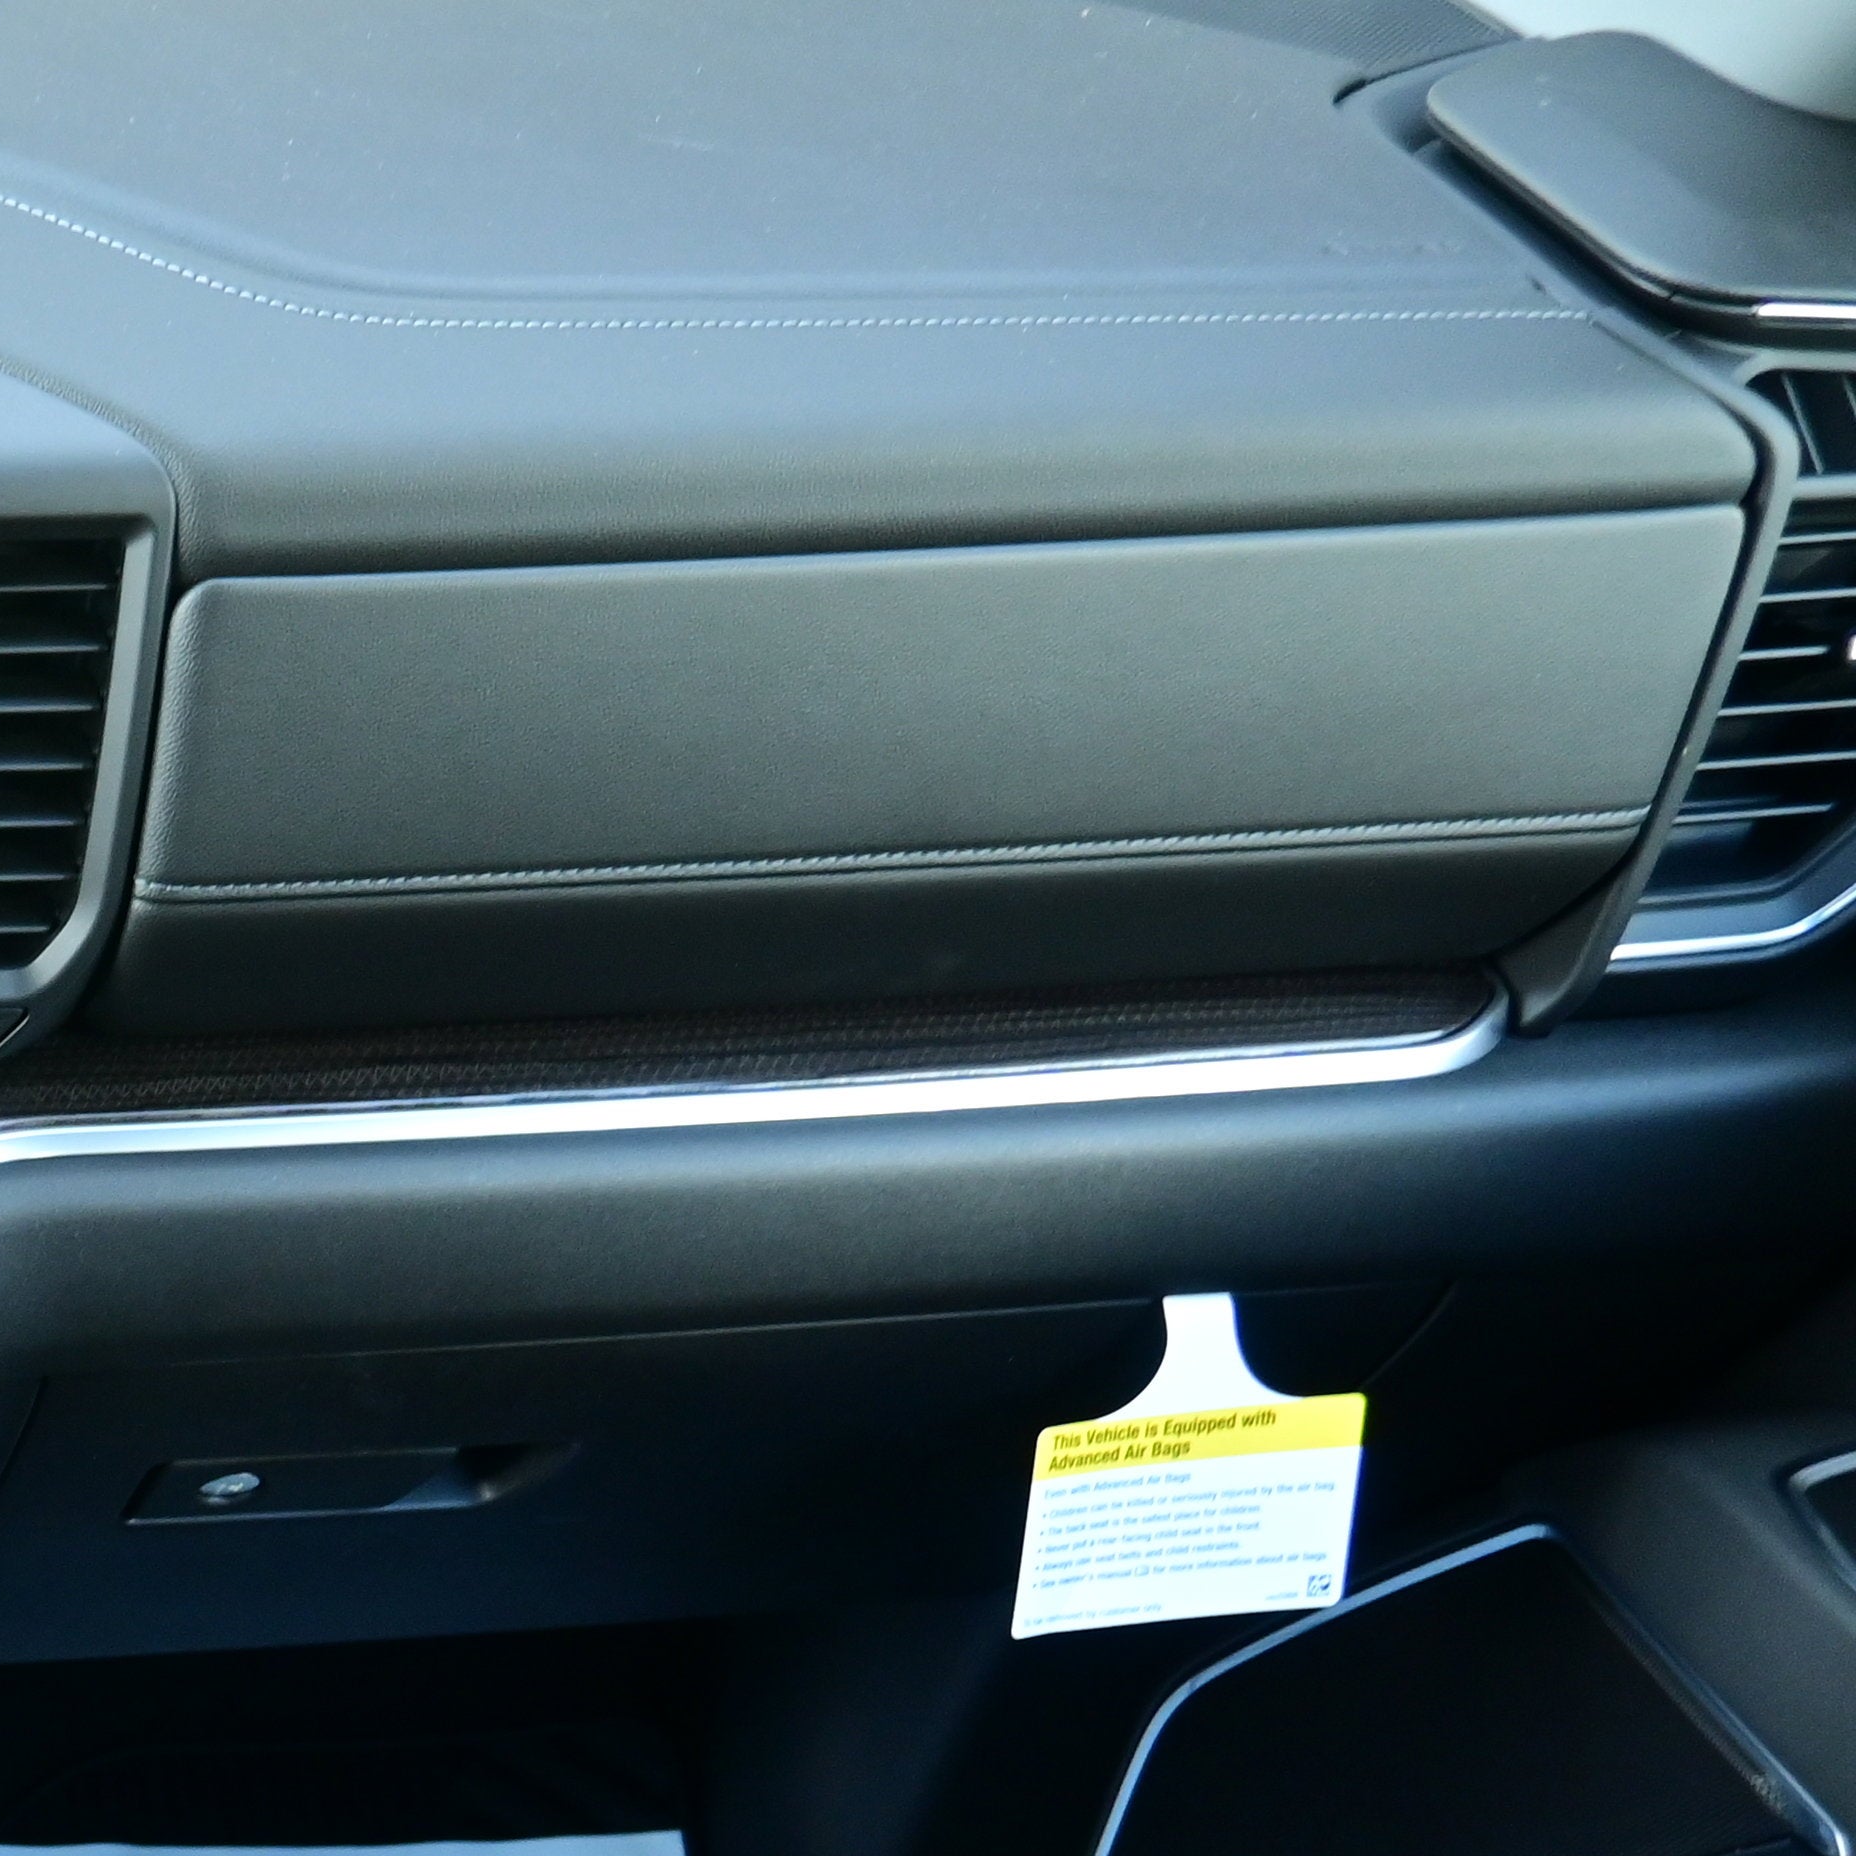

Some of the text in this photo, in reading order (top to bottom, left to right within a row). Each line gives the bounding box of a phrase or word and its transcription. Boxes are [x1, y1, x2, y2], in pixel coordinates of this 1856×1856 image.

[1053, 1409, 1277, 1451] This Vehicle is Equipped with
[1048, 1440, 1191, 1473] Advanced Air Bags
